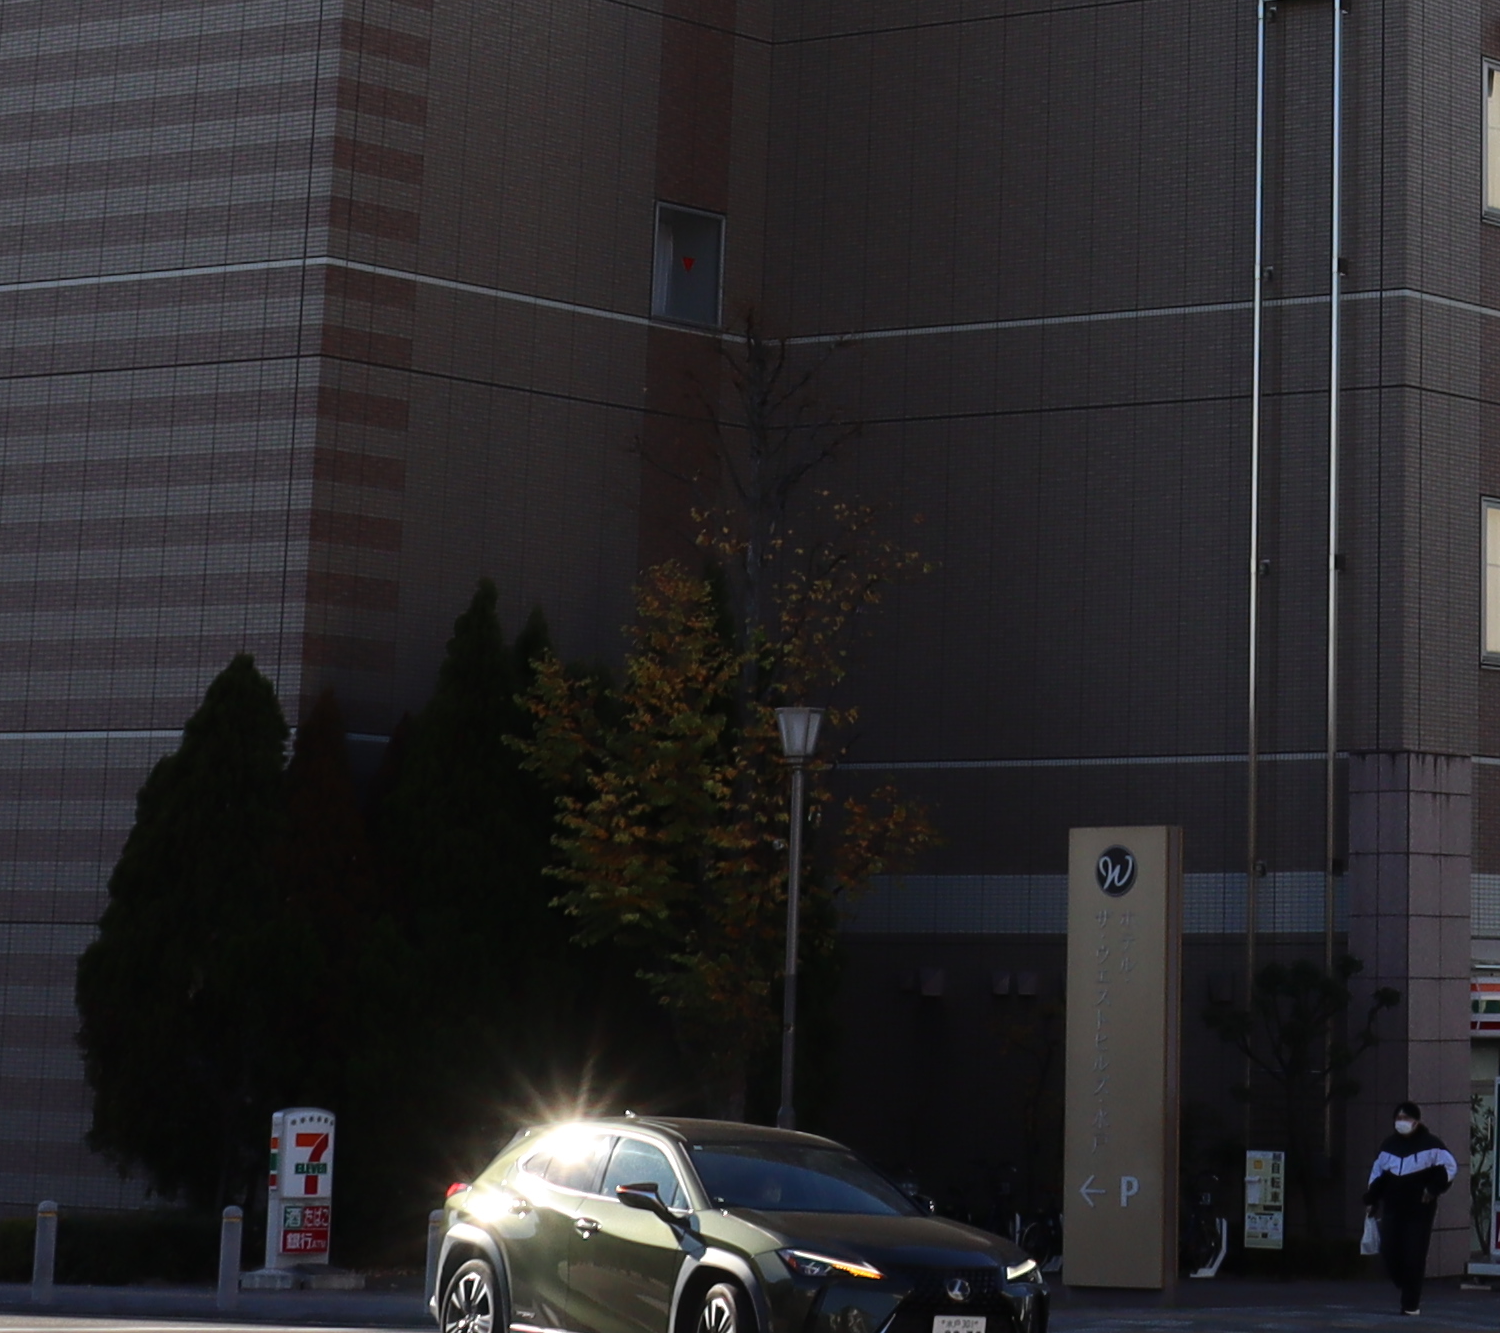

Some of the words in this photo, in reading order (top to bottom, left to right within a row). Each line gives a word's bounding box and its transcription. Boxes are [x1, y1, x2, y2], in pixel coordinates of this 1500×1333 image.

[1099, 855, 1132, 889] W
[1120, 1176, 1141, 1208] P
[284, 1207, 302, 1228] 酒
[304, 1207, 330, 1228] たばこ
[286, 1232, 313, 1250] 銀行
